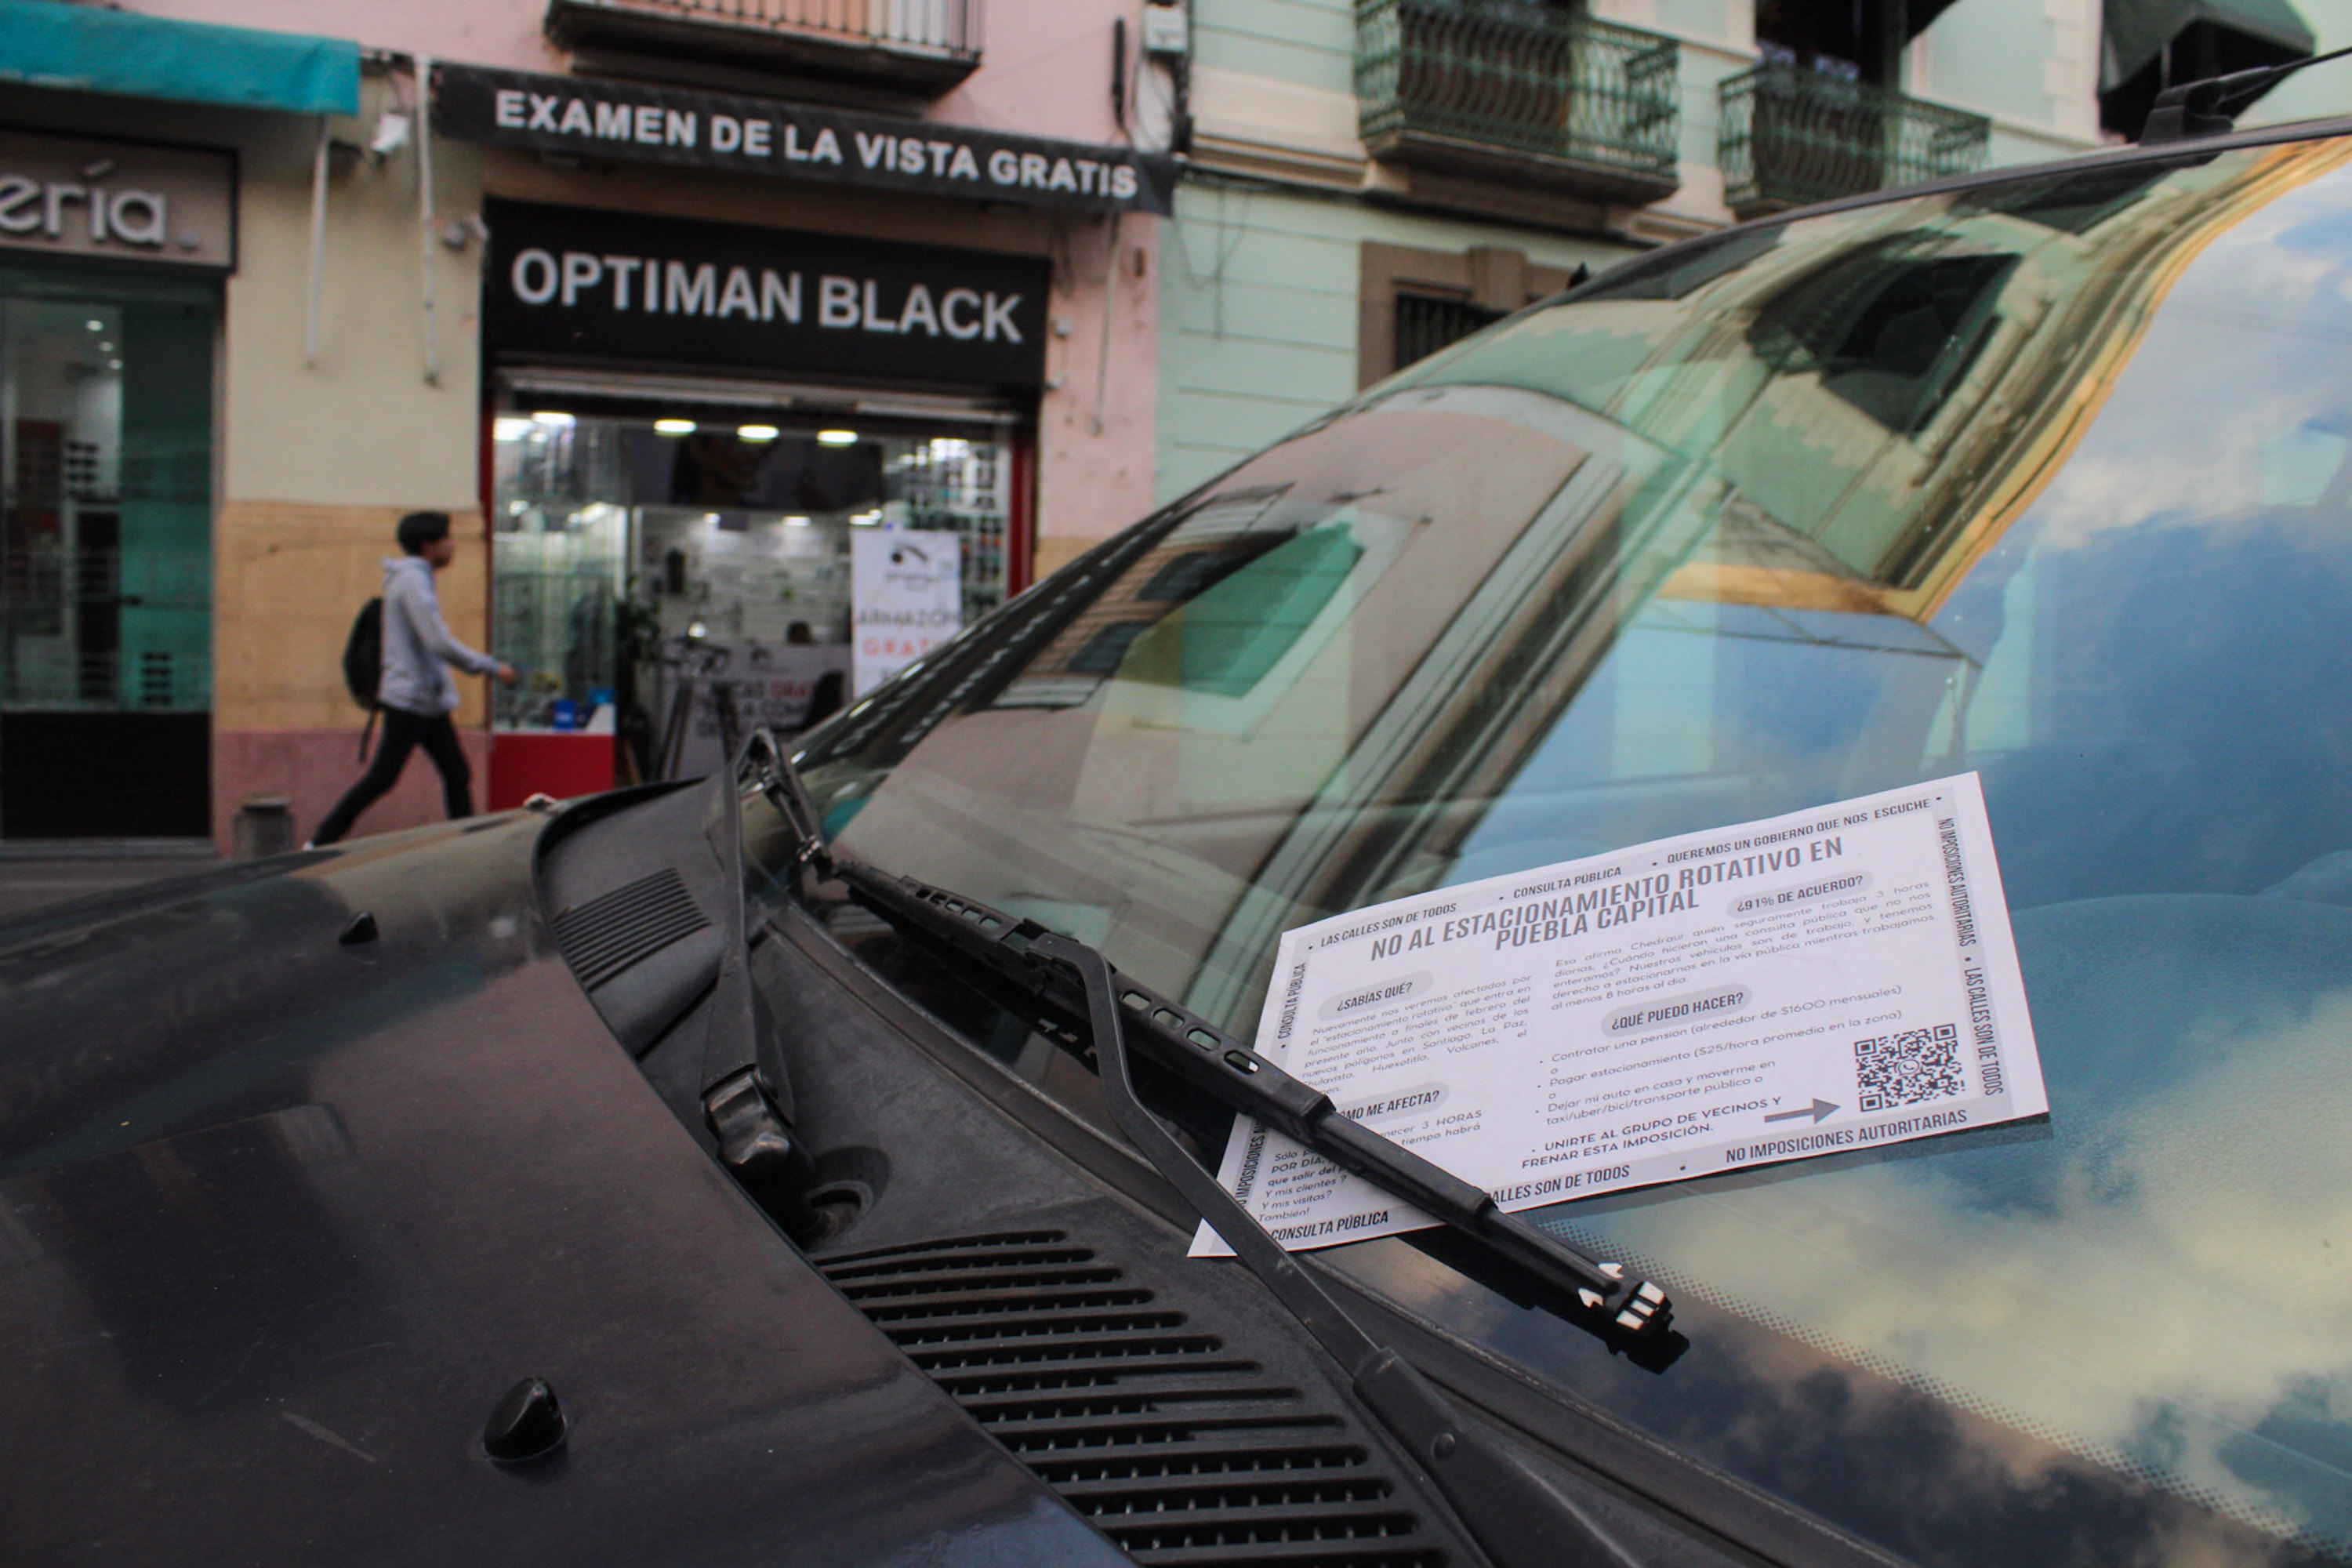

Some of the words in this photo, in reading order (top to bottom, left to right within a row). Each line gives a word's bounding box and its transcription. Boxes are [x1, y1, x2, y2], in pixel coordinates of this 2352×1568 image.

[495, 89, 697, 147] EXAMEN
[710, 115, 771, 156] DE
[784, 125, 843, 164] LA
[855, 132, 979, 180] VISTA
[988, 150, 1138, 199] GRATIS
[511, 249, 802, 322] OPTIMAN
[818, 275, 1023, 343] BLACK
[1668, 843, 1731, 864] QUEREMOS
[1734, 839, 1751, 851] UN
[1754, 825, 1813, 847] GOBIERNO
[1817, 818, 1840, 832] QUE
[1843, 812, 1868, 826] NOS
[1874, 798, 1930, 818] ESCUCHE
[1370, 935, 1403, 960] NO
[1408, 927, 1435, 951] AL
[1443, 874, 1670, 942] ESTACIONAMIENTO
[1679, 847, 1801, 890] ROTATIVO
[1810, 837, 1842, 862] EN
[1513, 878, 1571, 898] CONSULTA
[1574, 866, 1621, 886] PÚBLICA
[1777, 891, 1794, 904] DE
[1797, 875, 1863, 899] ACUERDO?
[1320, 933, 1340, 948] LAS
[1341, 922, 1380, 941] CALLES
[1381, 916, 1403, 930] SON
[1405, 911, 1419, 924] DE
[1423, 902, 1457, 919] TODOS
[1495, 913, 1588, 951] PUEBLA
[1597, 888, 1700, 929] CAPITAL
[1964, 967, 1984, 986] LAS
[1337, 989, 1382, 1011] ¿SABÍAS
[1384, 982, 1413, 999] QUÉ?
[1612, 1011, 1644, 1030] ¿QUÉ
[1648, 1004, 1689, 1023] PUEDO
[1693, 992, 1744, 1013] HACER?
[1967, 986, 1991, 1023] CALLES
[1552, 1045, 1611, 1062] Contratar
[1614, 1040, 1637, 1050] una
[1640, 1029, 1687, 1046] pensión
[1691, 1014, 1758, 1035] (alrededor
[1760, 1011, 1777, 1019] de
[1829, 985, 1902, 1006] mensuales)
[1973, 1023, 1994, 1045] SON
[1549, 1073, 1587, 1087] Pagar
[1590, 1052, 1691, 1078] estacionamiento
[1762, 1026, 1825, 1045] promedio
[1828, 1022, 1845, 1031] en
[1865, 1010, 1902, 1025] zona)
[1977, 1045, 1998, 1061] DE
[1548, 1099, 1581, 1112] Dejar
[1584, 1094, 1599, 1104] mi
[1602, 1090, 1631, 1101] auto
[1634, 1085, 1650, 1094] en
[1653, 1079, 1682, 1091] casa
[1686, 1076, 1693, 1085] y
[1697, 1065, 1755, 1081] moverme
[1980, 1060, 2004, 1096] TODOS
[1366, 1102, 1385, 1116] ME
[1386, 1090, 1439, 1112] AFECTA?
[1422, 1121, 1429, 1130] 3
[1436, 1109, 1482, 1127] HORAS
[1544, 1133, 1595, 1151] UNIRTE
[1600, 1129, 1617, 1140] AL
[1622, 1118, 1672, 1135] GRUPO
[1677, 1112, 1697, 1124] DE
[1701, 1099, 1768, 1119] VECINOS
[1773, 1096, 1781, 1105] Y
[1726, 1147, 1746, 1163] NO
[1750, 1130, 1854, 1159] IMPOSICIONES
[1858, 1109, 1967, 1142] AUTORITARIAS
[1522, 1150, 1579, 1169] FRENAR
[1583, 1142, 1618, 1156] ESTA
[1623, 1123, 1713, 1149] IMPOSICIÓN.
[1268, 1177, 1289, 1187] que
[1318, 1166, 1335, 1175] del
[1275, 1188, 1293, 1196] mis
[1296, 1178, 1336, 1193] clientes
[1493, 1184, 1532, 1203] ALLES
[1534, 1178, 1562, 1196] SON
[1565, 1173, 1582, 1189] DE
[1586, 1164, 1630, 1185] TODOS
[1271, 1200, 1290, 1209] mis
[1293, 1189, 1333, 1205] visitas?
[1271, 1221, 1334, 1241] CONSULTA
[1336, 1210, 1388, 1232] PÚBLICA
